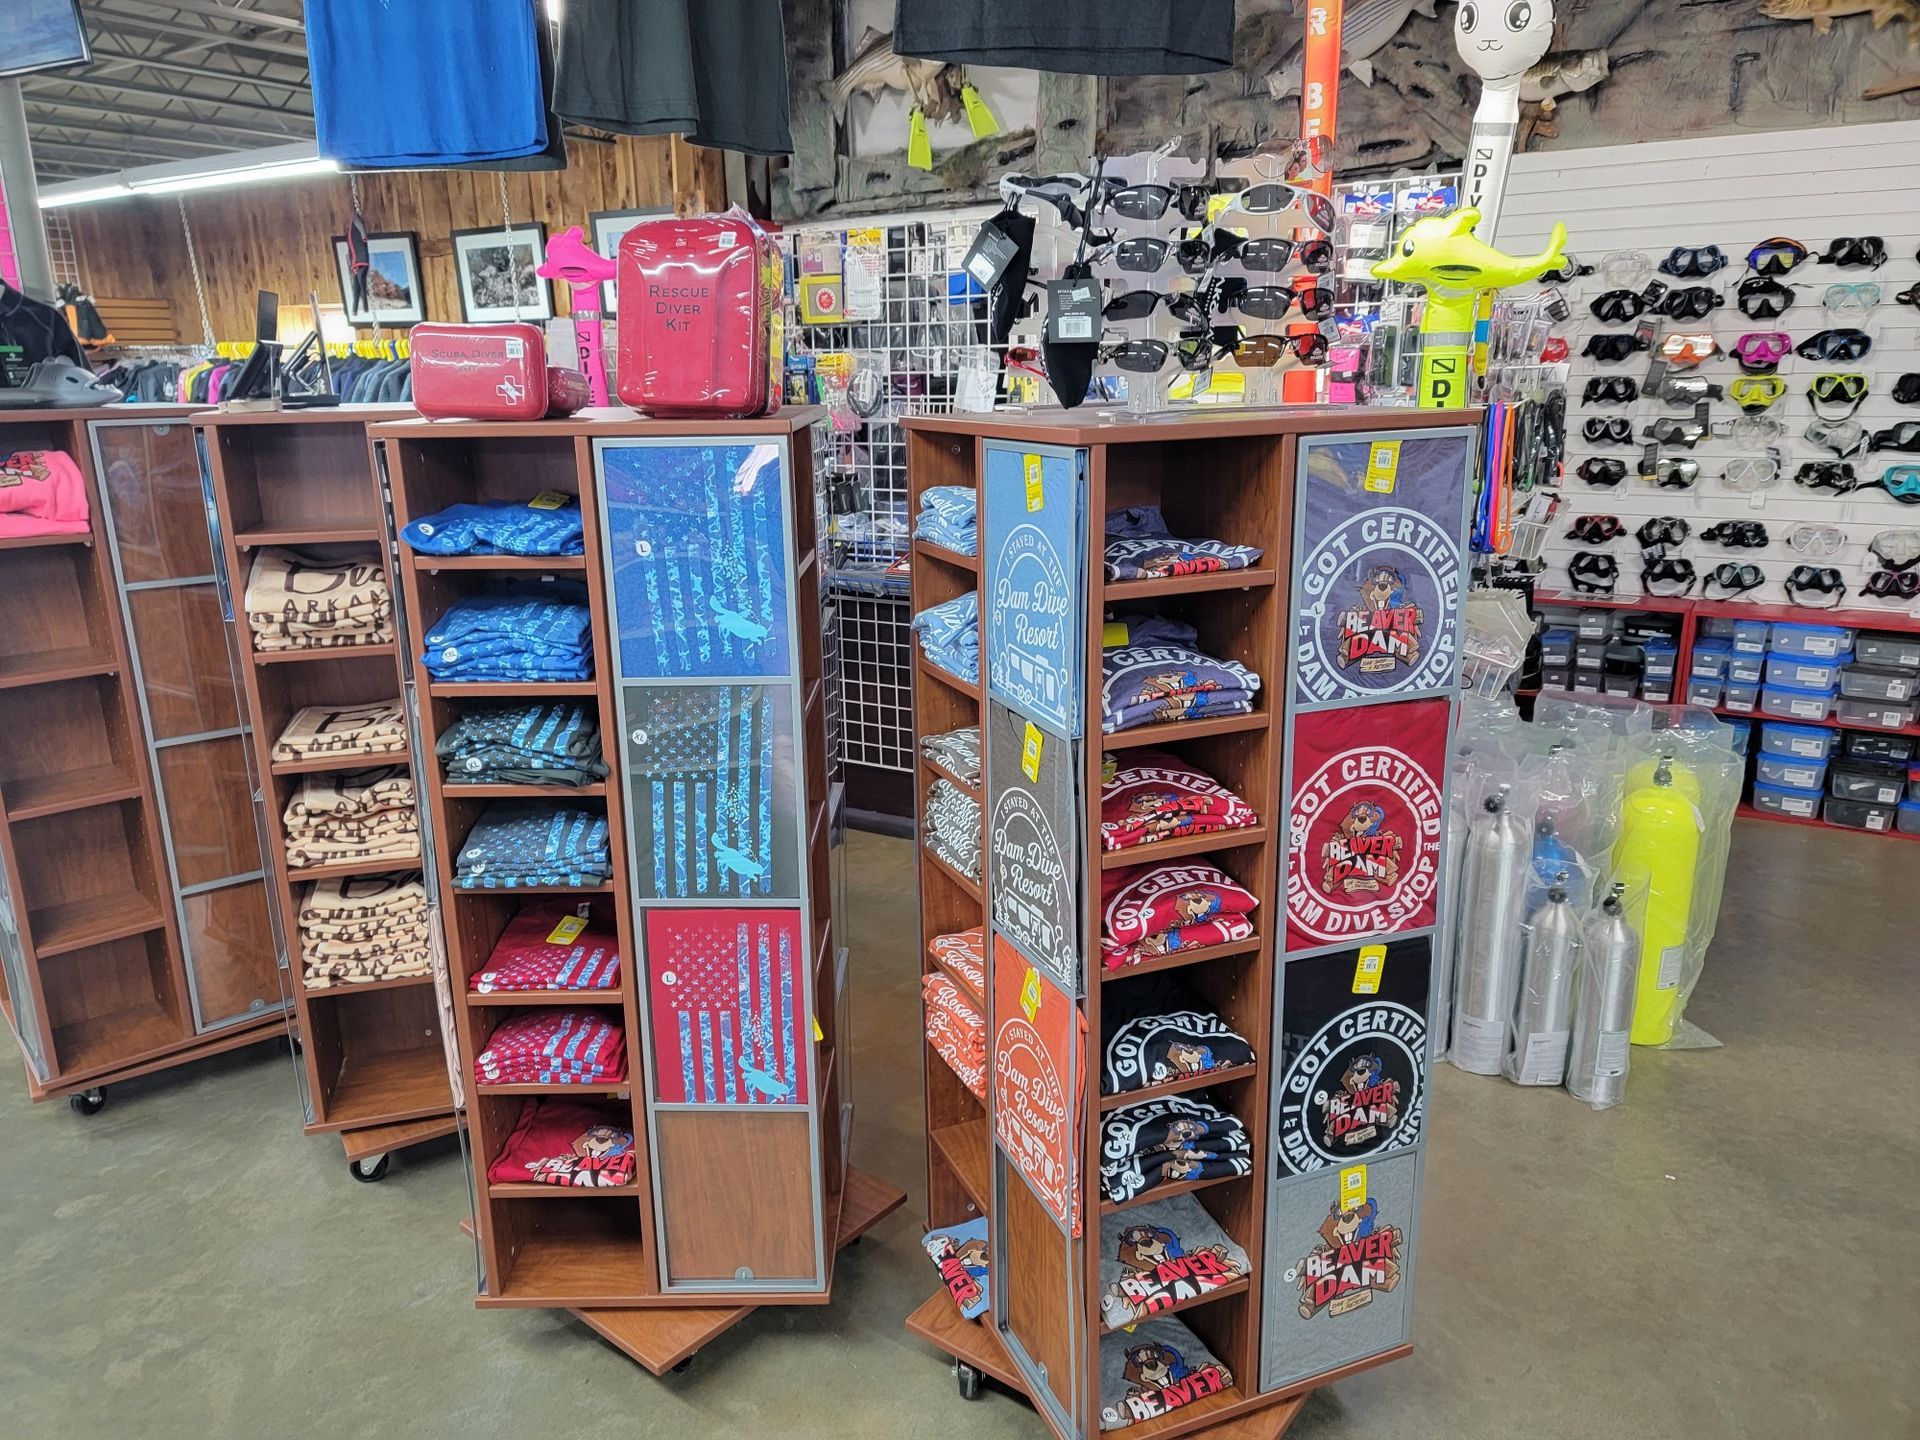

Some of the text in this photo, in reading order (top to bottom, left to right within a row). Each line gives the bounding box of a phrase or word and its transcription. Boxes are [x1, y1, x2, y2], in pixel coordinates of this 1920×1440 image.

[1470, 164, 1487, 207] DIV
[1009, 534, 1035, 560] STAYED
[1037, 542, 1047, 556] AT
[1049, 559, 1063, 589] THE
[1304, 532, 1351, 595] GOT
[997, 578, 1069, 616] Dam Dive
[1015, 613, 1060, 650] Resort
[1346, 608, 1417, 638] BEAVER
[1350, 630, 1409, 660] DAM
[1004, 798, 1028, 816] STAYED
[1031, 809, 1041, 823] AT
[1291, 774, 1332, 833] GOT
[1342, 755, 1440, 836] CERTIFIED
[994, 828, 1062, 880] Dam Dive
[1329, 835, 1395, 867] BEAVER
[1333, 855, 1386, 883] DAM
[1011, 864, 1054, 906] Resort
[1288, 856, 1434, 932] DAM DIVE SHOP
[1116, 899, 1142, 931] GOT
[1009, 1028, 1034, 1045] STAYED
[1115, 1034, 1143, 1078] GOT
[1290, 1035, 1331, 1094] GOT
[998, 1050, 1029, 1092] Dam
[1031, 1077, 1065, 1122] Dive
[1330, 1082, 1393, 1115] BEAVER
[1015, 1090, 1056, 1143] Resort
[1283, 1117, 1298, 1130] AT
[1334, 1102, 1387, 1137] DAM
[541, 1153, 634, 1173] BEAVER
[1120, 1250, 1231, 1304] BEAVER
[1306, 1231, 1393, 1284] BEAVER
[1315, 1257, 1386, 1306] DAM
[1126, 1366, 1224, 1424] BEAVER
